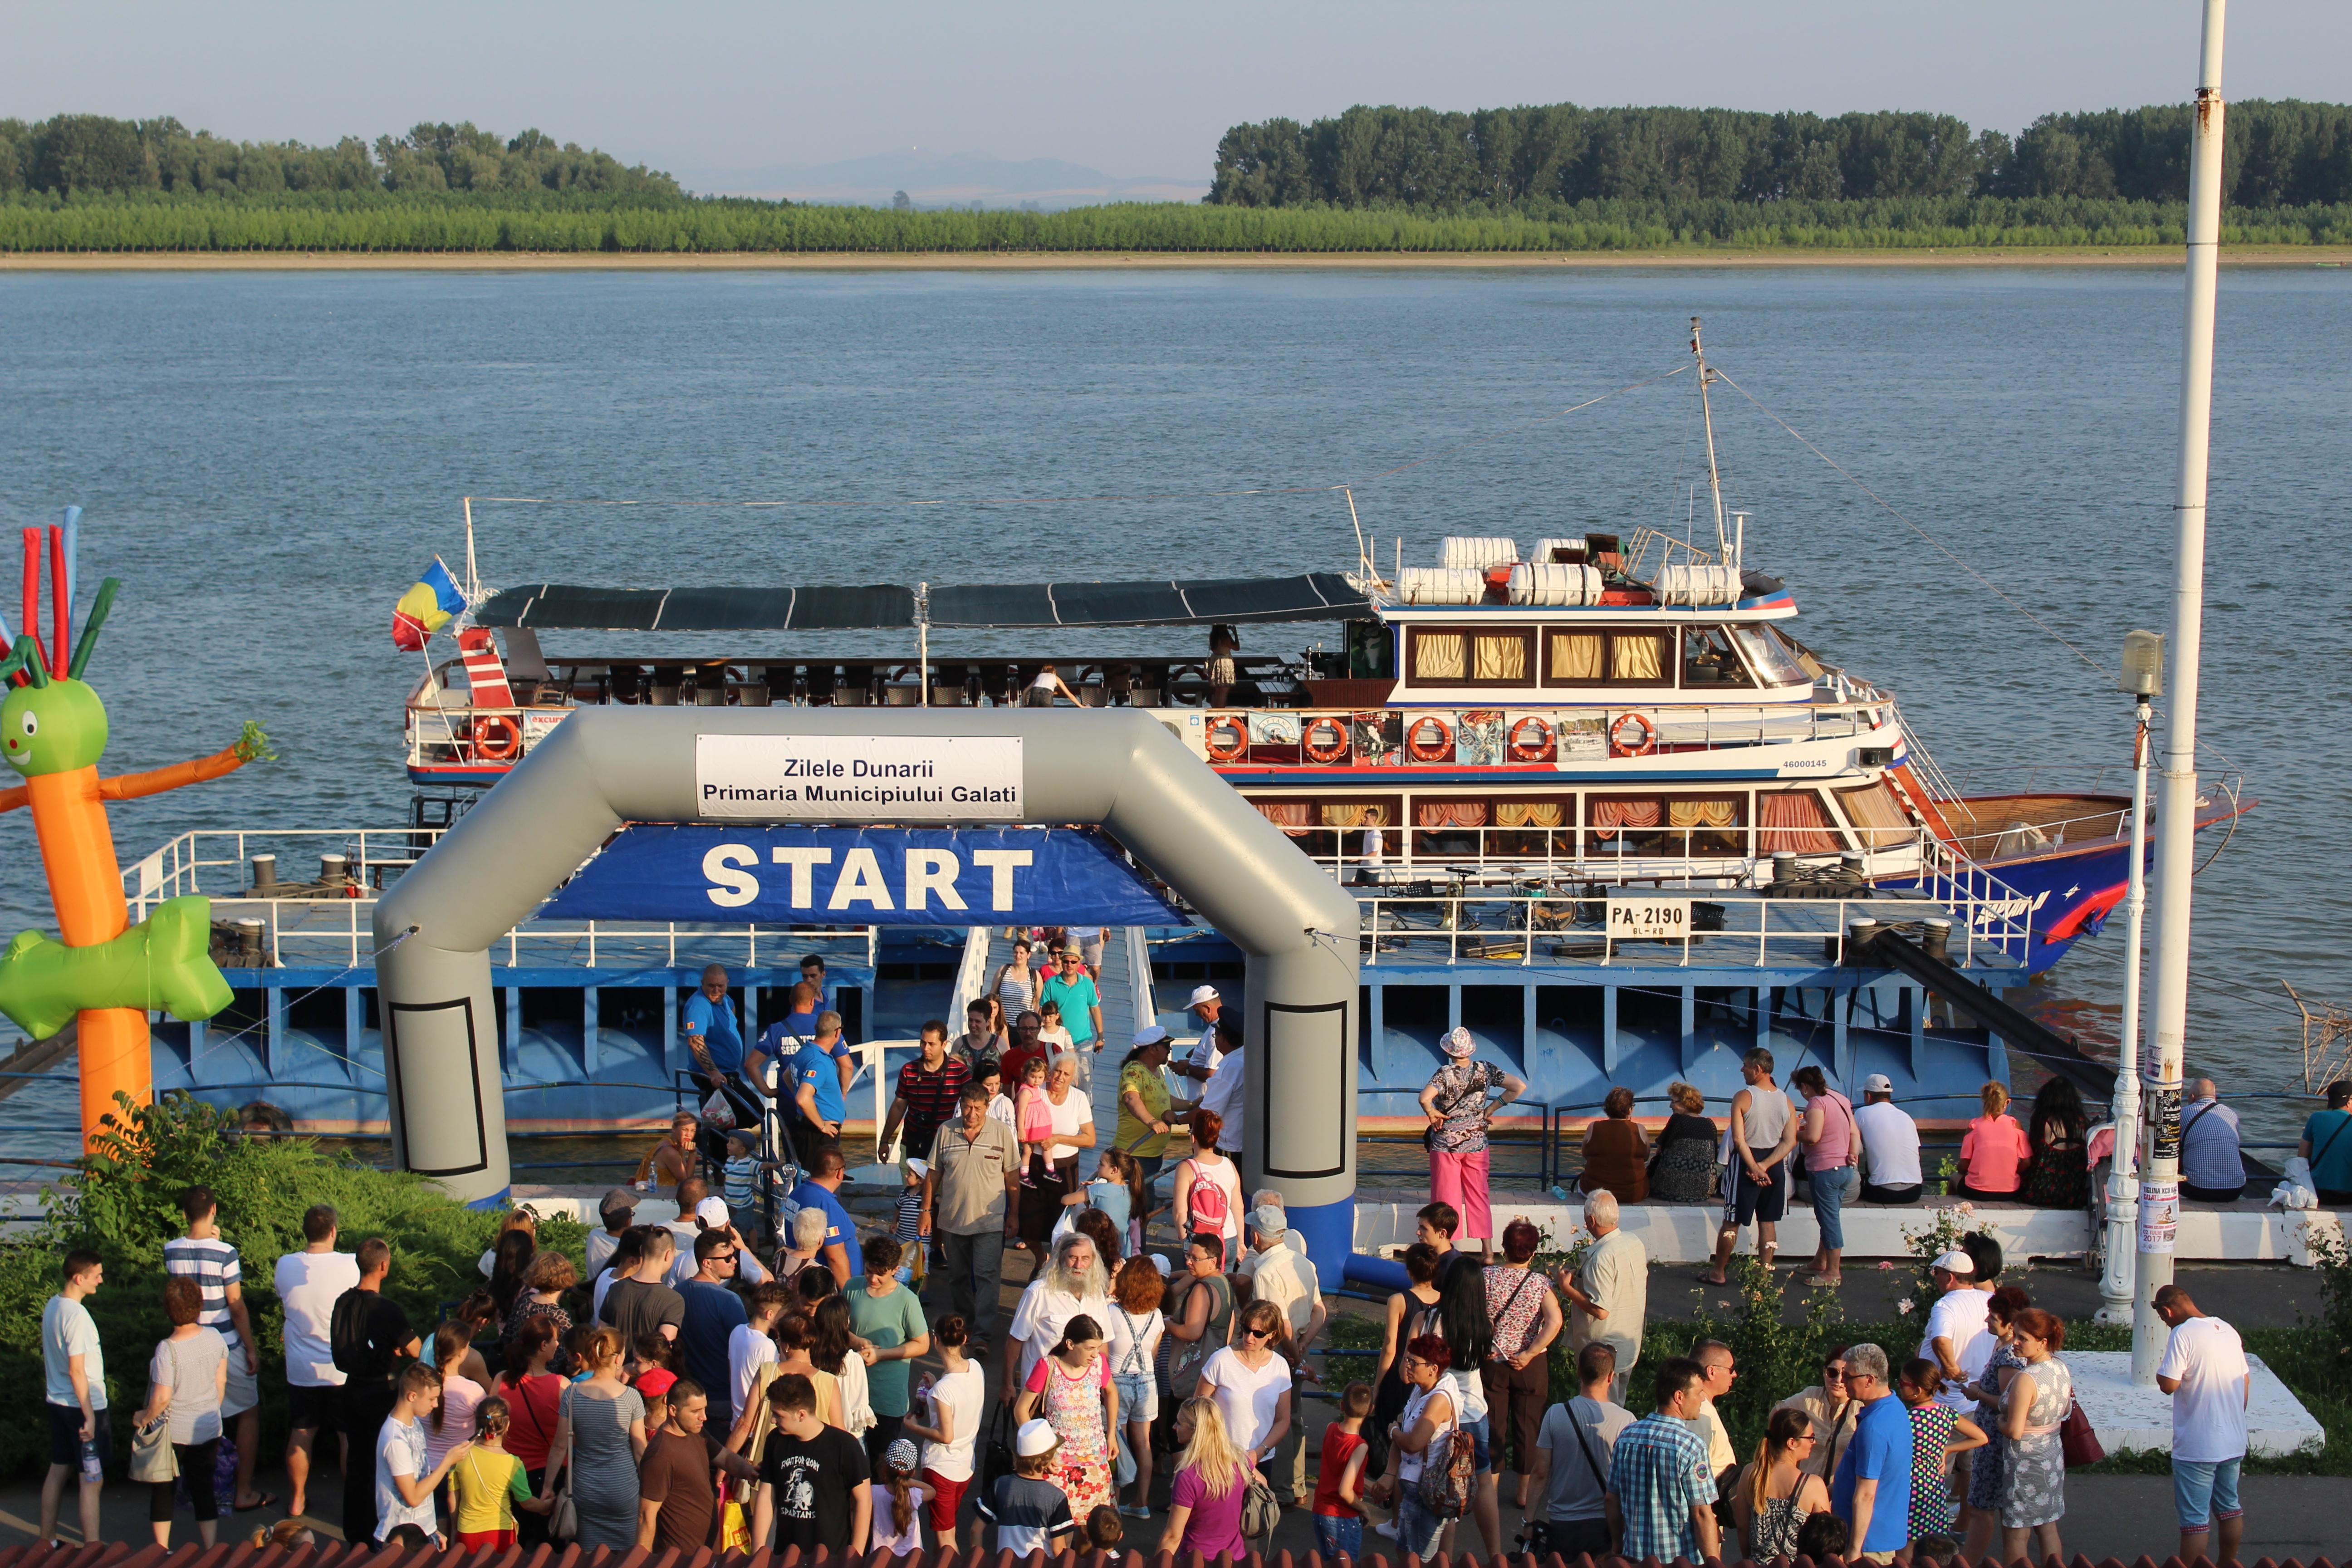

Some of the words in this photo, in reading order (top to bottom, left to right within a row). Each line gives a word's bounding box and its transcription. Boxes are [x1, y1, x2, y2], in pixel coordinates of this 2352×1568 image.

[1307, 744, 1341, 760] GALATI
[1421, 736, 1450, 759] GALATI
[784, 759, 844, 777] Zilele
[853, 759, 933, 777] Dunarii
[703, 784, 797, 801] Primaria
[806, 786, 943, 805] Municipiului
[951, 786, 1015, 802] Galati
[702, 843, 1033, 911] START
[2143, 1186, 2161, 1194] TIGLINA
[781, 1457, 795, 1470] FIGHT
[794, 1455, 805, 1465] FOR
[805, 1457, 820, 1471] GLORY
[781, 1507, 816, 1519] SPARTANS
